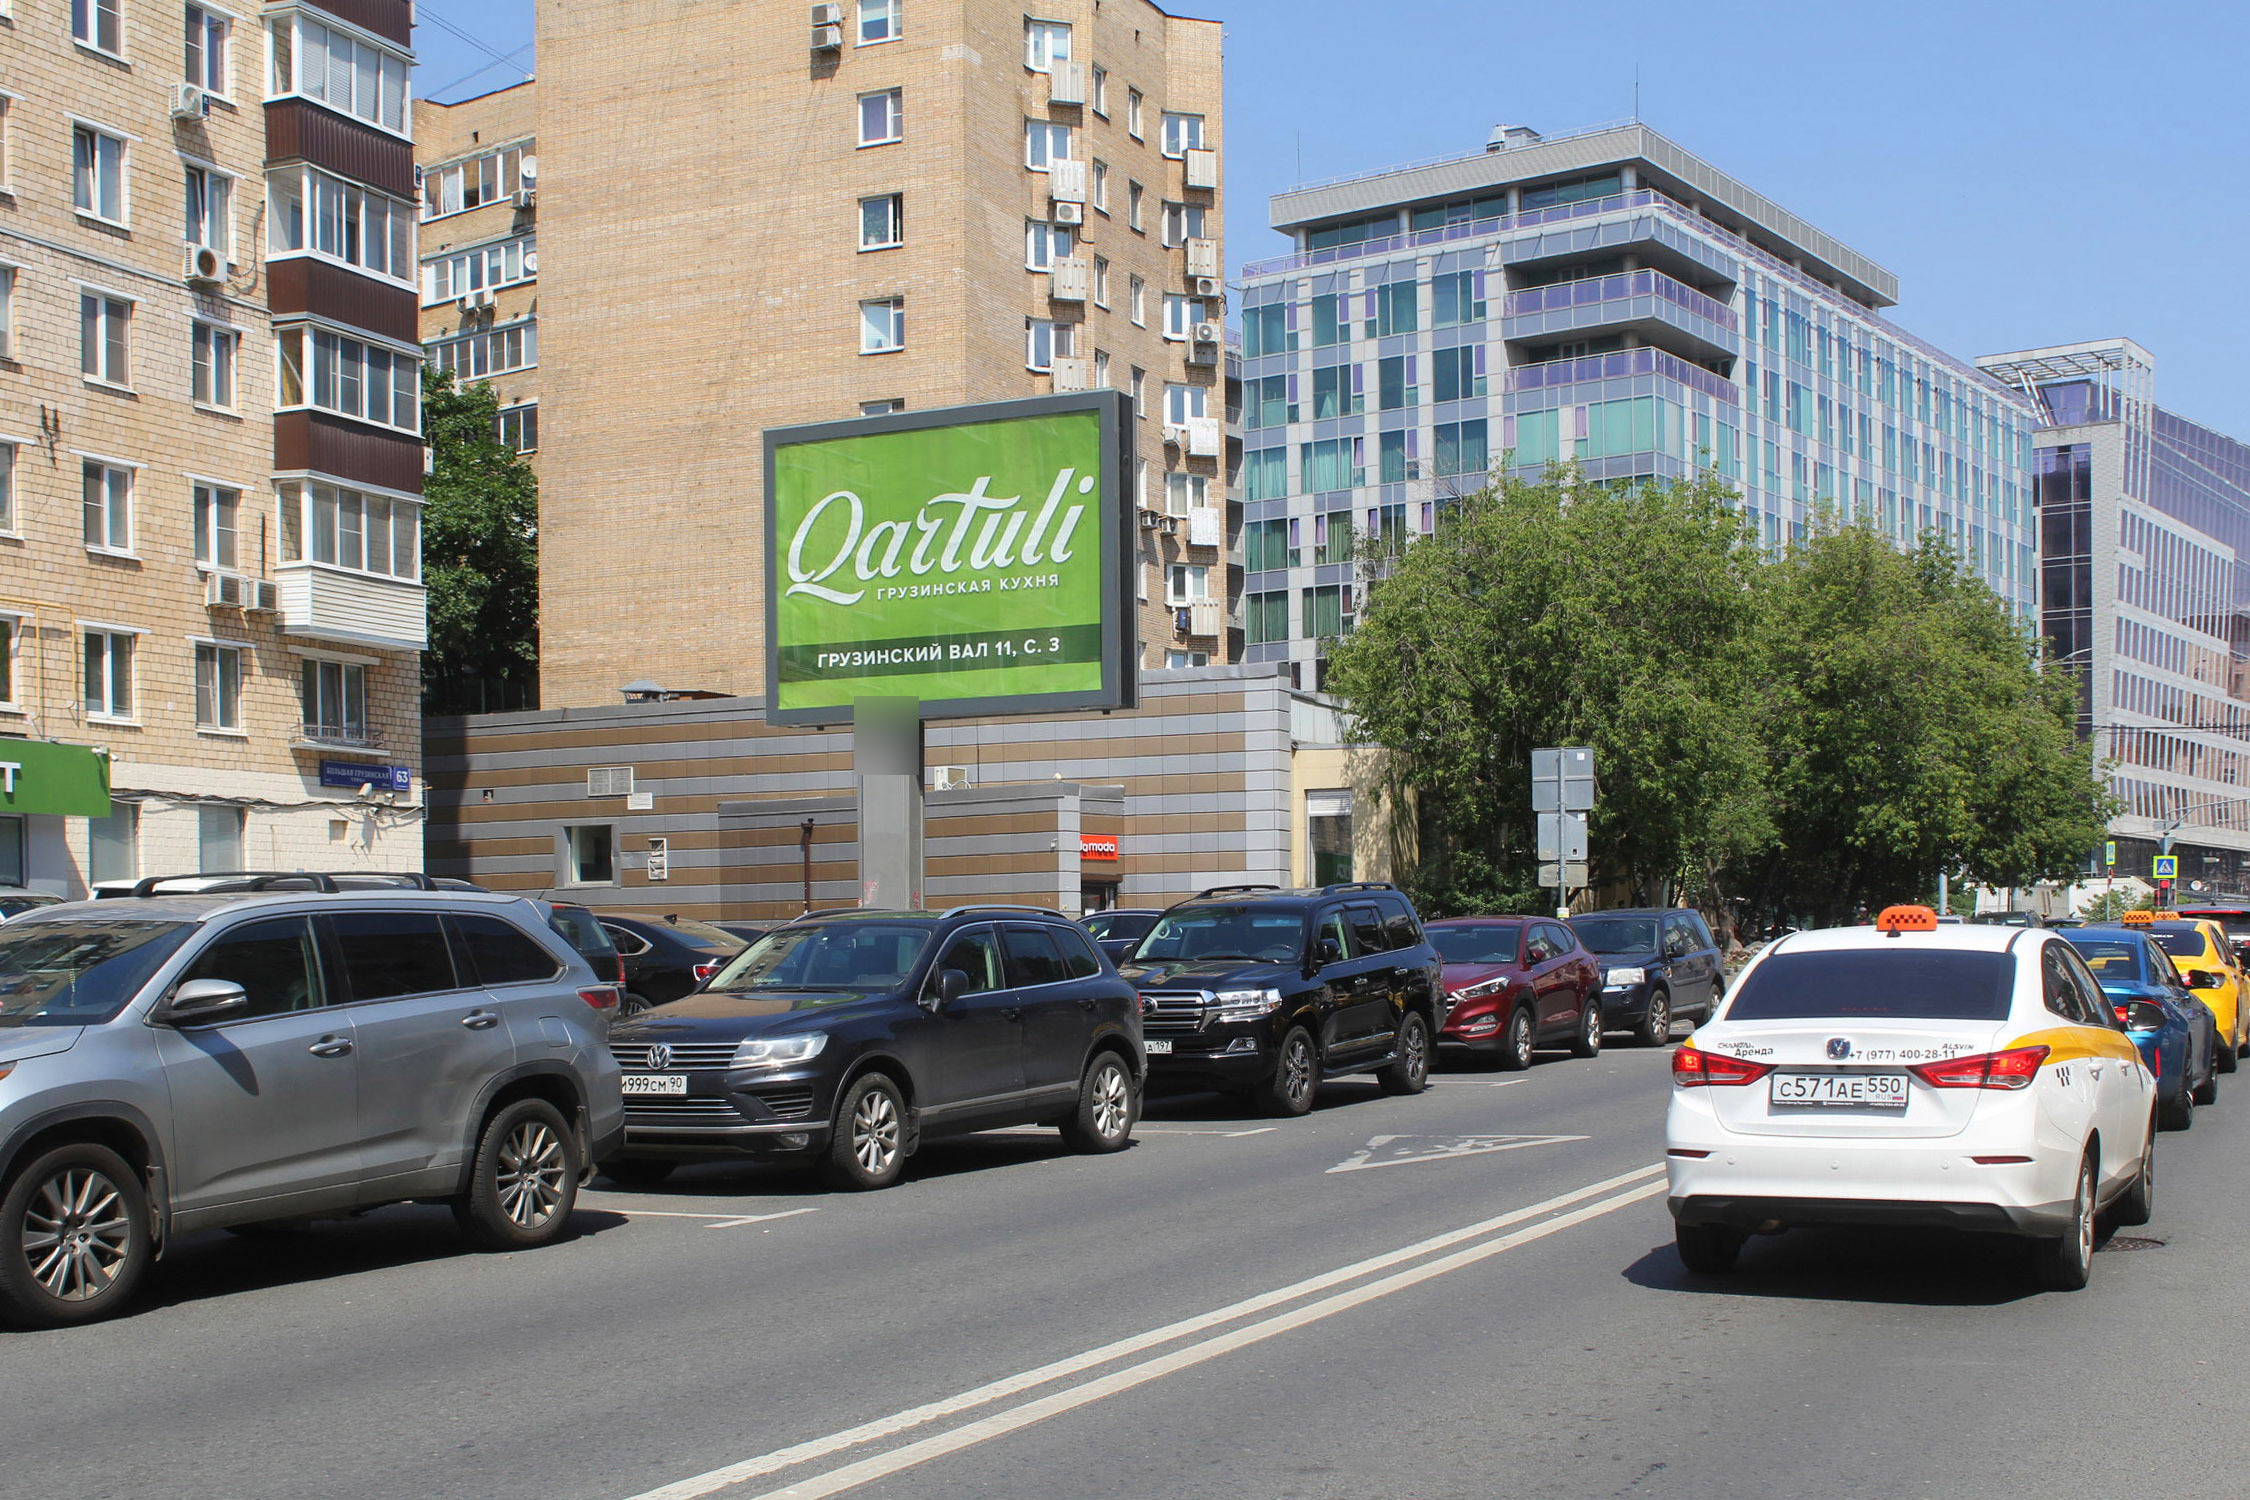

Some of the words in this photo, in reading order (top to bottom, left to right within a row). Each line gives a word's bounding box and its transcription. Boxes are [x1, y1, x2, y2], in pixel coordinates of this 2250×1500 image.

[785, 467, 1095, 606] Qartuli
[877, 579, 991, 600] ГРУЗИНСКАЯ
[1000, 574, 1059, 590] КУХНЯ
[817, 642, 942, 668] ГРУЗИНСКИЙ
[949, 642, 988, 660] ВАЛ
[995, 640, 1017, 657] 11,
[1049, 637, 1060, 652] 3
[396, 770, 408, 783] 63
[1734, 1048, 1774, 1058] Аренда
[1849, 1050, 1862, 1060] +7
[1866, 1050, 1896, 1061] (977)
[1899, 1050, 1956, 1060] 400-28-11
[669, 1077, 682, 1088] 90
[1867, 1077, 1901, 1093] 550
